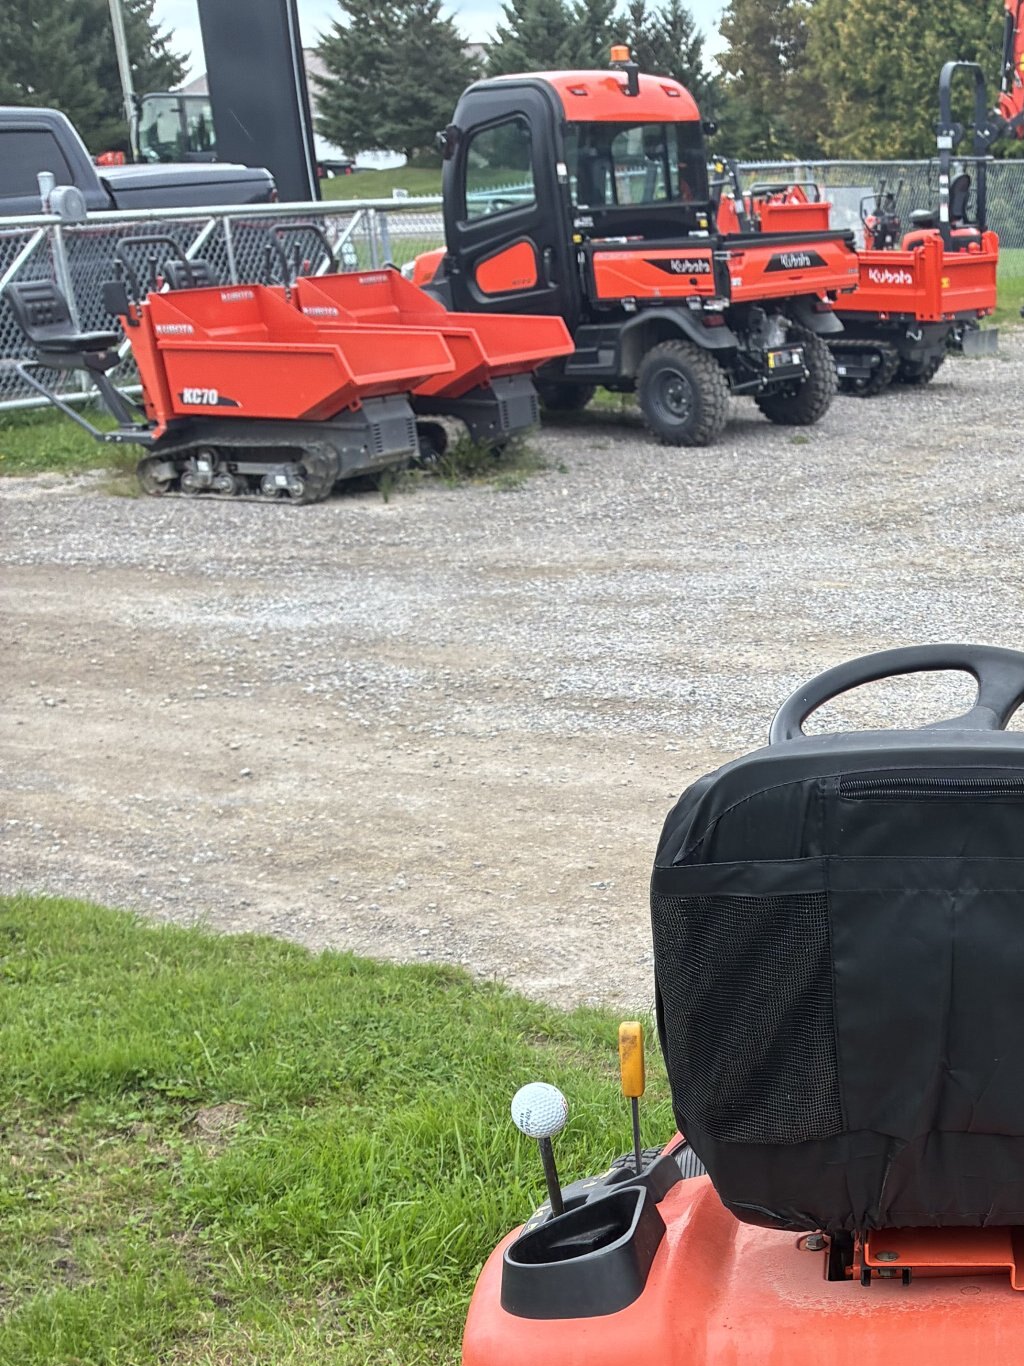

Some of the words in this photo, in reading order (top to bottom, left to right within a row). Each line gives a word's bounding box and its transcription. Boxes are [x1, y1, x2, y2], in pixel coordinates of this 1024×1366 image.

[670, 259, 710, 274] Kubota
[780, 253, 811, 268] Kubota
[868, 268, 913, 285] Kubota
[182, 388, 219, 406] KC70
